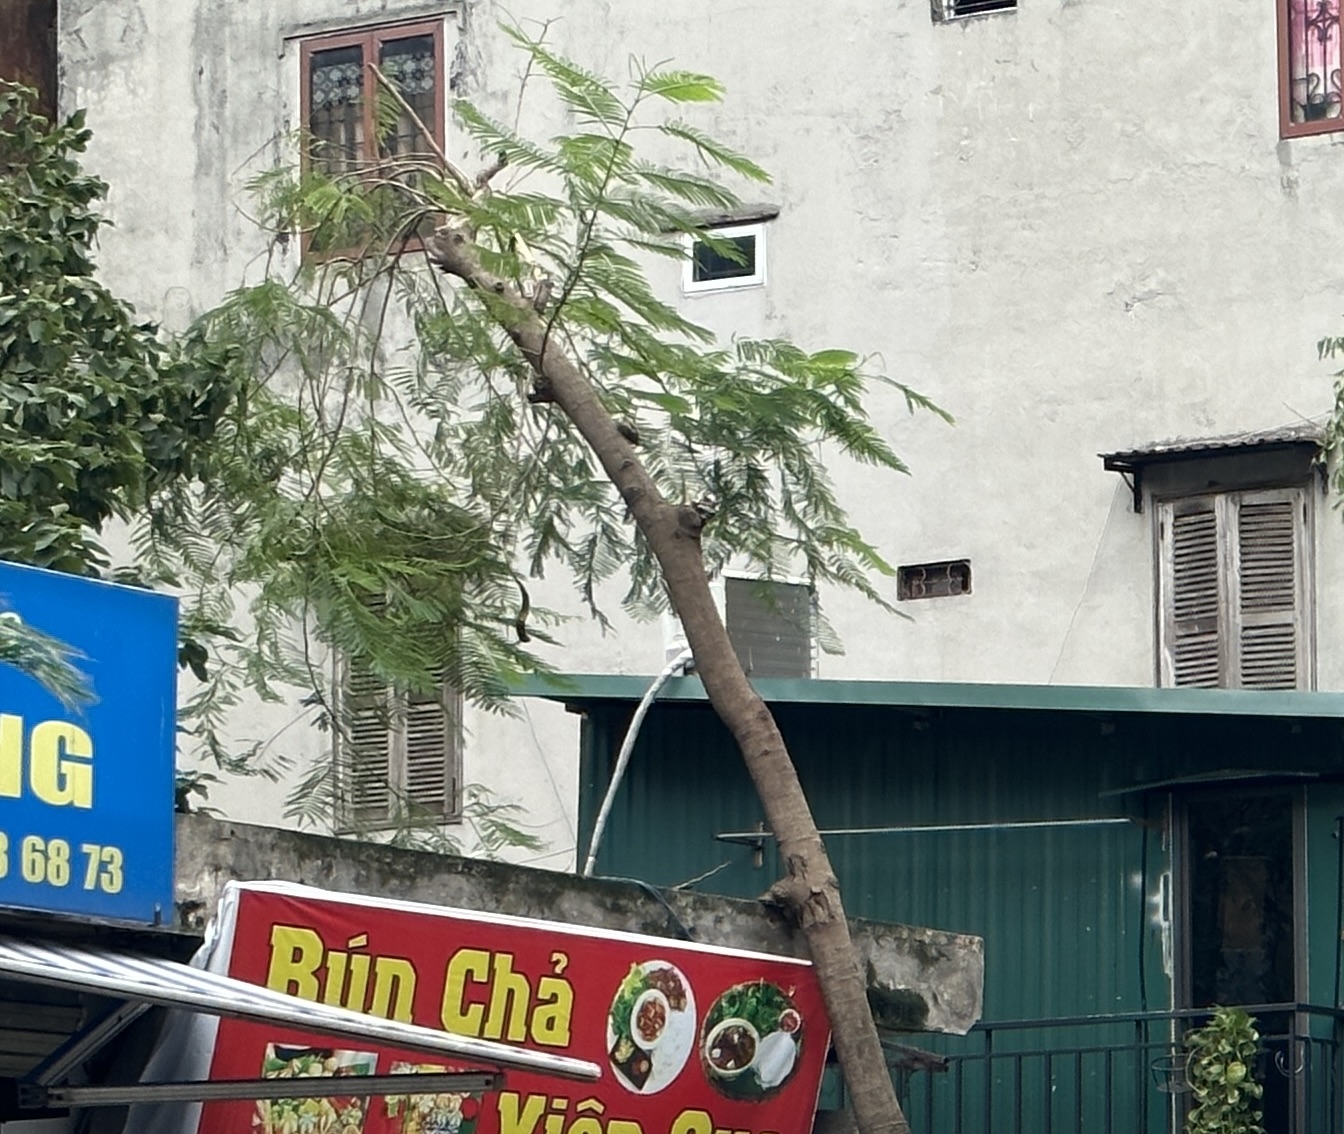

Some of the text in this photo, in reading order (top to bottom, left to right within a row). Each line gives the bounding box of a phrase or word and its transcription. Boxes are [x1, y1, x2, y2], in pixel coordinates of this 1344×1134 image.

[22, 835, 70, 887] 68
[82, 843, 123, 894] 73
[266, 924, 574, 1047] Bún Chả
